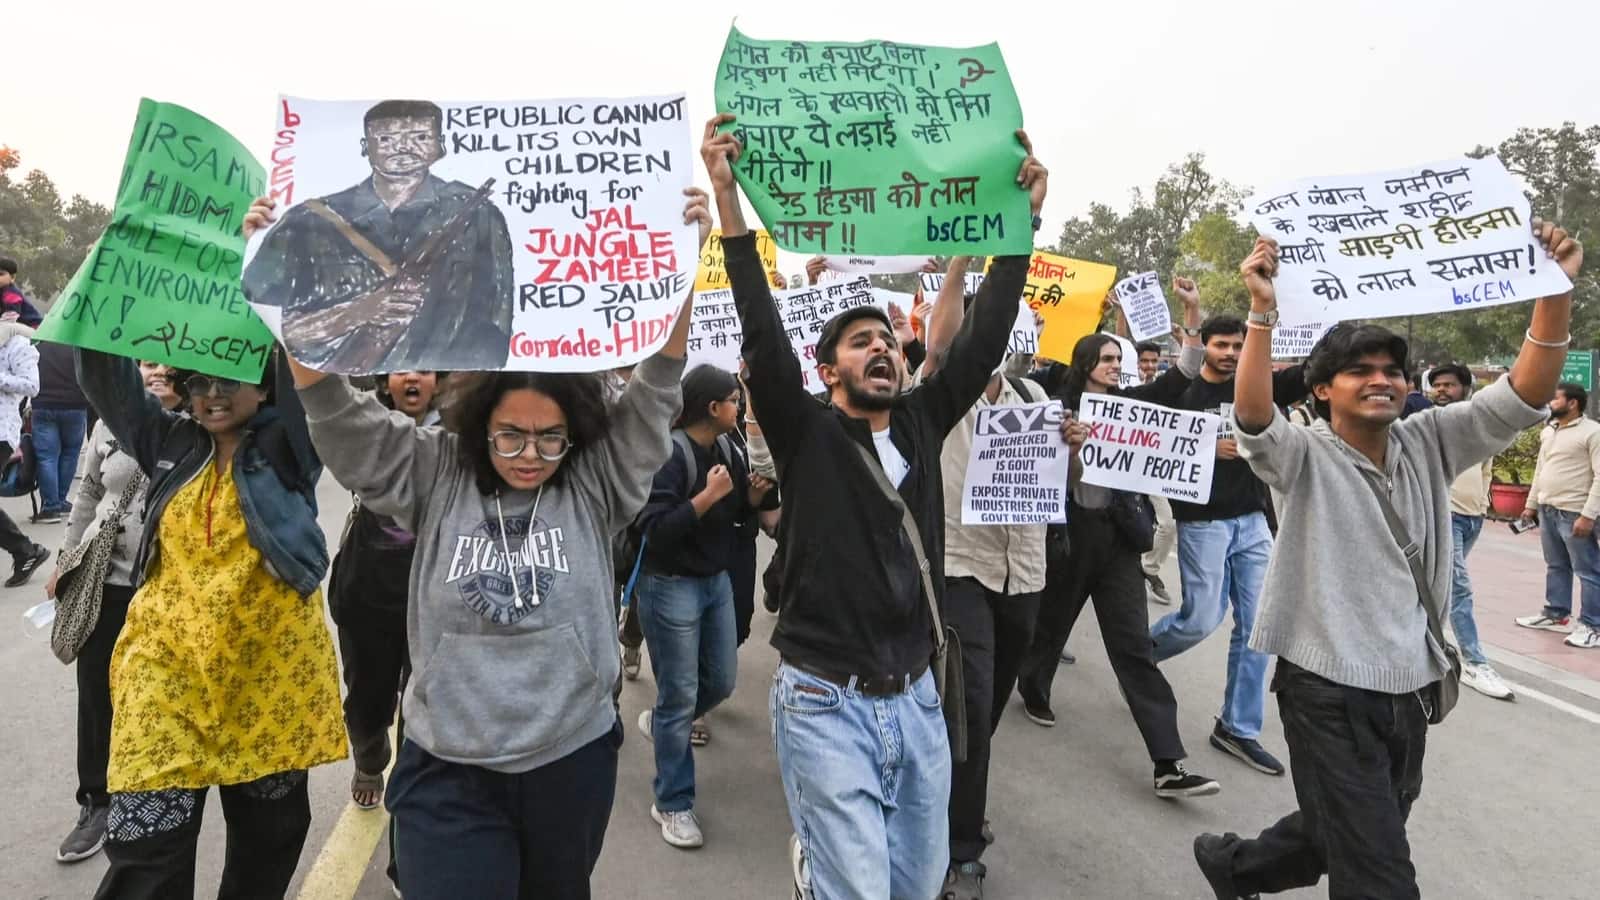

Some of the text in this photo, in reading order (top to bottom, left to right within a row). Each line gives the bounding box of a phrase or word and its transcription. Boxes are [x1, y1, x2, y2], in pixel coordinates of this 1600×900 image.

[781, 41, 812, 64] को
[447, 96, 686, 130] REPUBLIC CANNOT
[788, 88, 819, 113] के
[914, 86, 943, 118] को
[452, 127, 642, 153] KILL ITS OWN
[505, 150, 672, 175] CHILDREN
[503, 179, 643, 219] fighting for
[887, 171, 929, 208] को
[1255, 191, 1301, 216] जल
[1385, 167, 1470, 196] जमीन
[139, 170, 243, 237] HIDM
[585, 204, 647, 231] JAL
[927, 213, 1005, 243] bsCEM
[1269, 216, 1295, 234] के
[525, 228, 675, 258] JUNGLE
[534, 254, 678, 285] ZAMEEN
[519, 284, 586, 312] RED
[600, 272, 688, 305] SALUTE
[1311, 269, 1348, 301] को
[1357, 268, 1416, 294] लाल
[1452, 279, 1516, 305] bsCEM
[593, 305, 635, 329] TO
[1279, 330, 1313, 339] WHY NO
[1088, 399, 1122, 420] THE
[1128, 405, 1181, 430] STATE
[1189, 416, 1206, 434] IS
[990, 434, 1048, 448] UNCHECKED
[1088, 421, 1199, 456] KILLING ITS
[979, 447, 1056, 460] AIR POLLUTION
[996, 460, 1035, 471] IS GOVT
[1083, 445, 1201, 484] OWN PEOPLE
[992, 473, 1038, 485] FAILURE!
[971, 487, 1059, 500] EXPOSE PRIVATE
[971, 500, 1059, 513] INDUSTRIES AND
[981, 513, 1010, 522] GOVT
